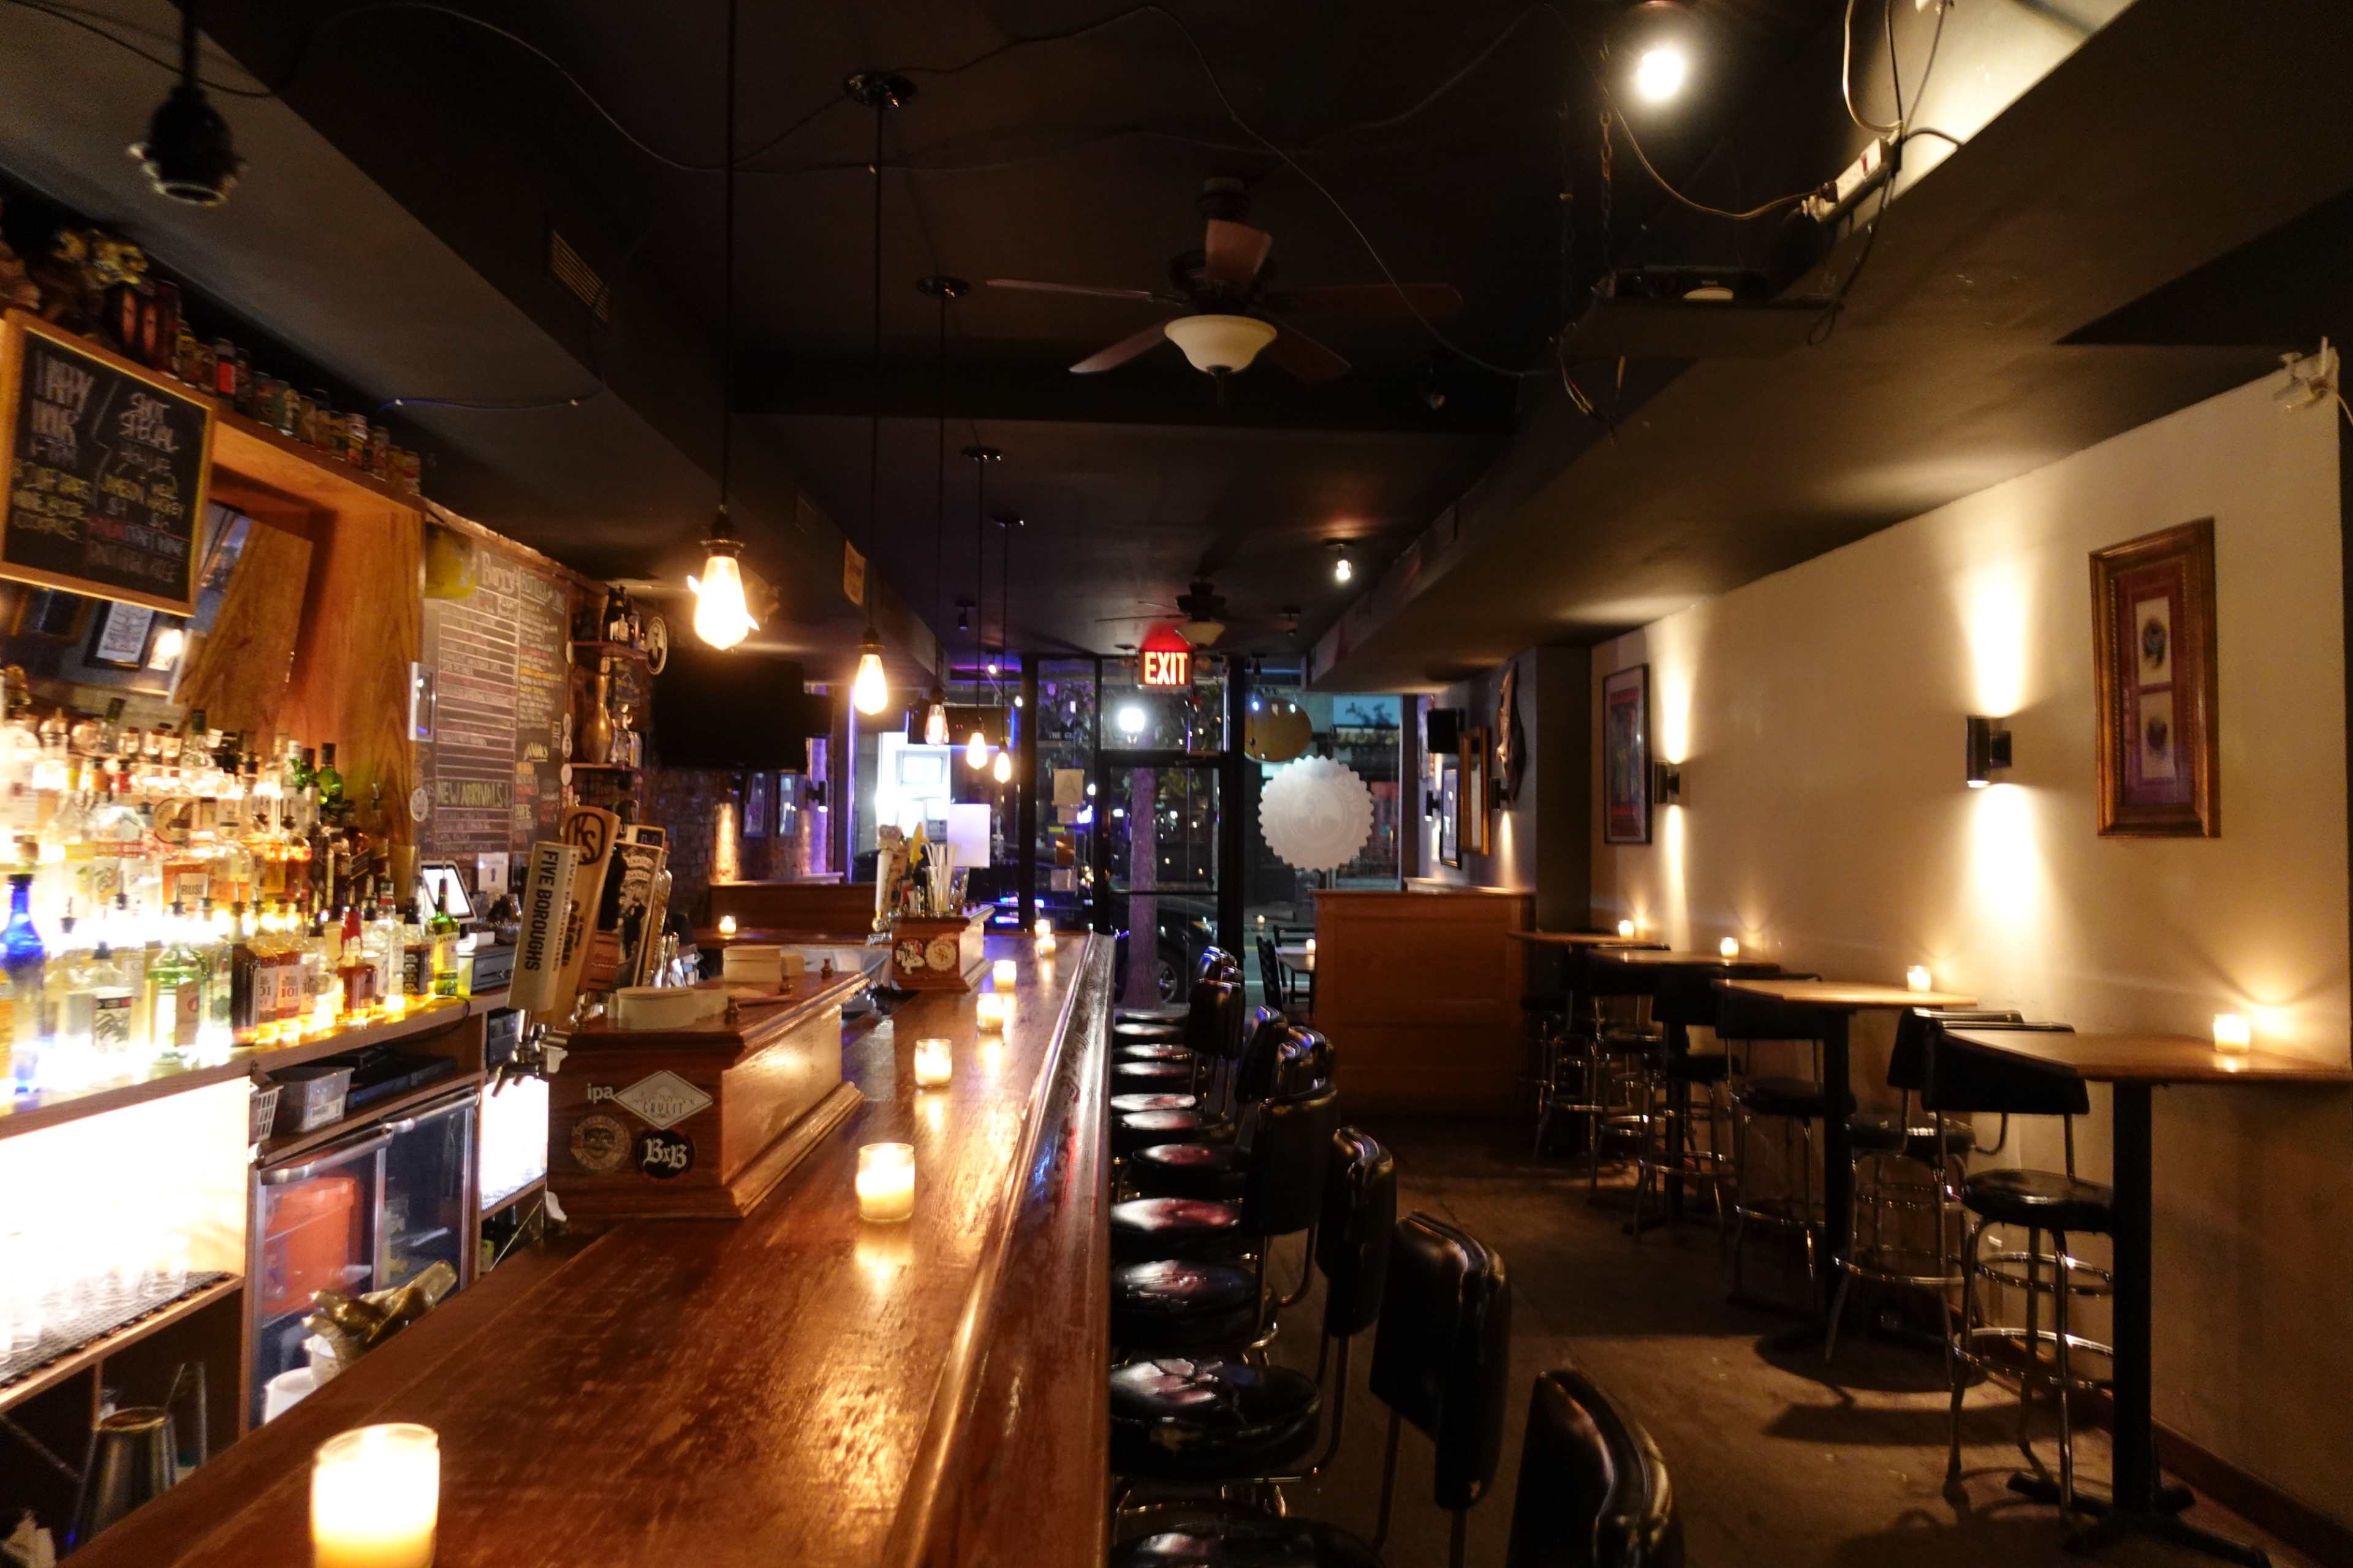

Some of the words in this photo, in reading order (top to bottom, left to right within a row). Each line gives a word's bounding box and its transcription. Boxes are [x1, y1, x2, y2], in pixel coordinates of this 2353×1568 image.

[1144, 651, 1188, 685] EXIT
[437, 781, 460, 805] NEW
[539, 850, 559, 886] FIVE
[525, 888, 553, 971] BOROUGHS
[587, 1083, 613, 1104] ipa
